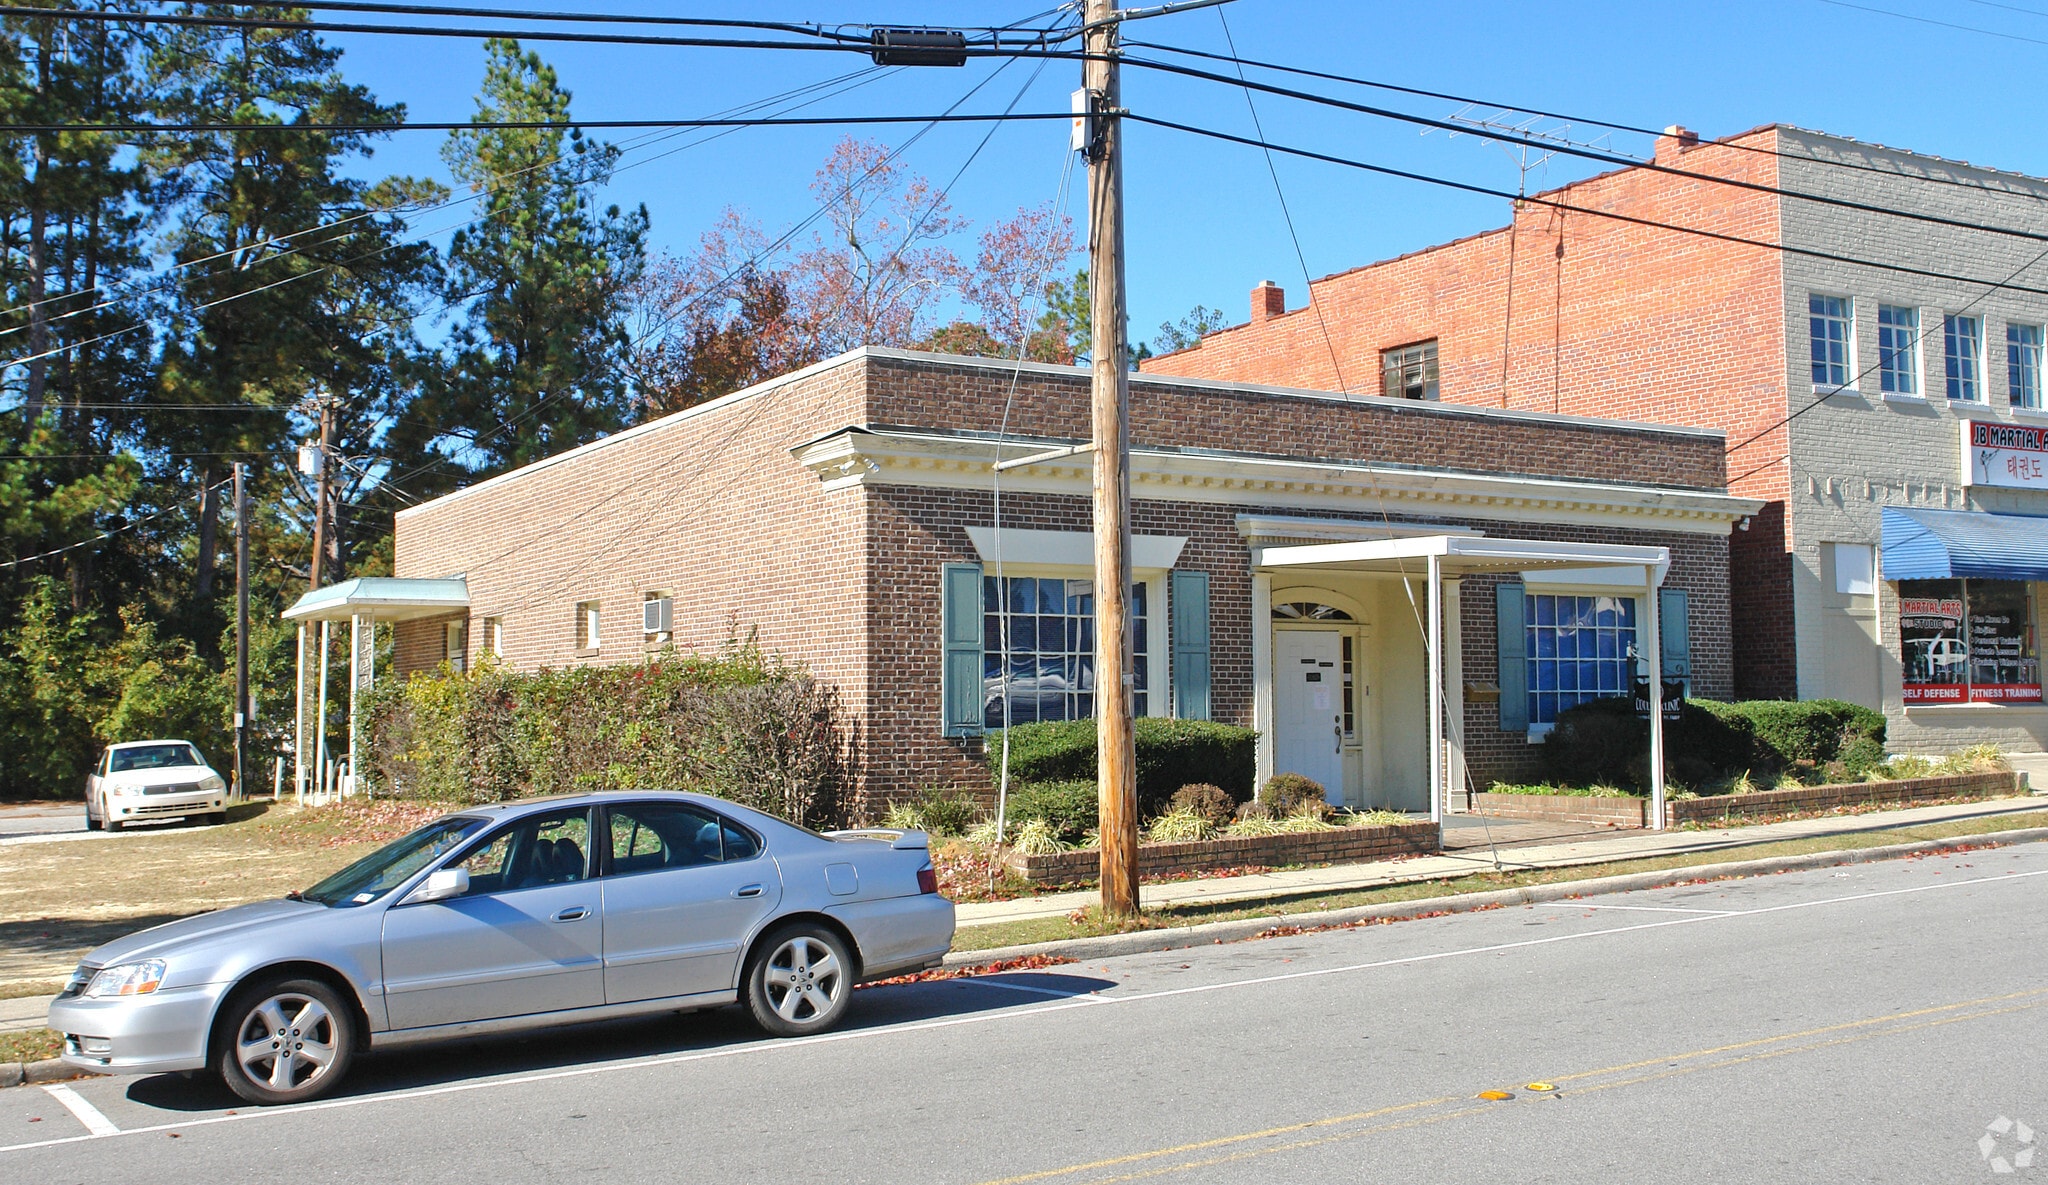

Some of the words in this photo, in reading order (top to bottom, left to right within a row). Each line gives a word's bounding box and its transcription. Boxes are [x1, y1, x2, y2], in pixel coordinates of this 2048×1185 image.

[1974, 425, 1987, 445] JB
[1989, 426, 2040, 449] MARTIAL
[2007, 455, 2043, 480] 태권도
[1904, 600, 1939, 614] MARTIAL
[1941, 601, 1961, 617] ARTS
[1914, 619, 1943, 629] STUDIO
[1903, 688, 1922, 698] SELF
[1924, 688, 1961, 698] DEFENSE
[1971, 688, 2003, 698] FITNESS
[2005, 688, 2041, 698] TRAINING
